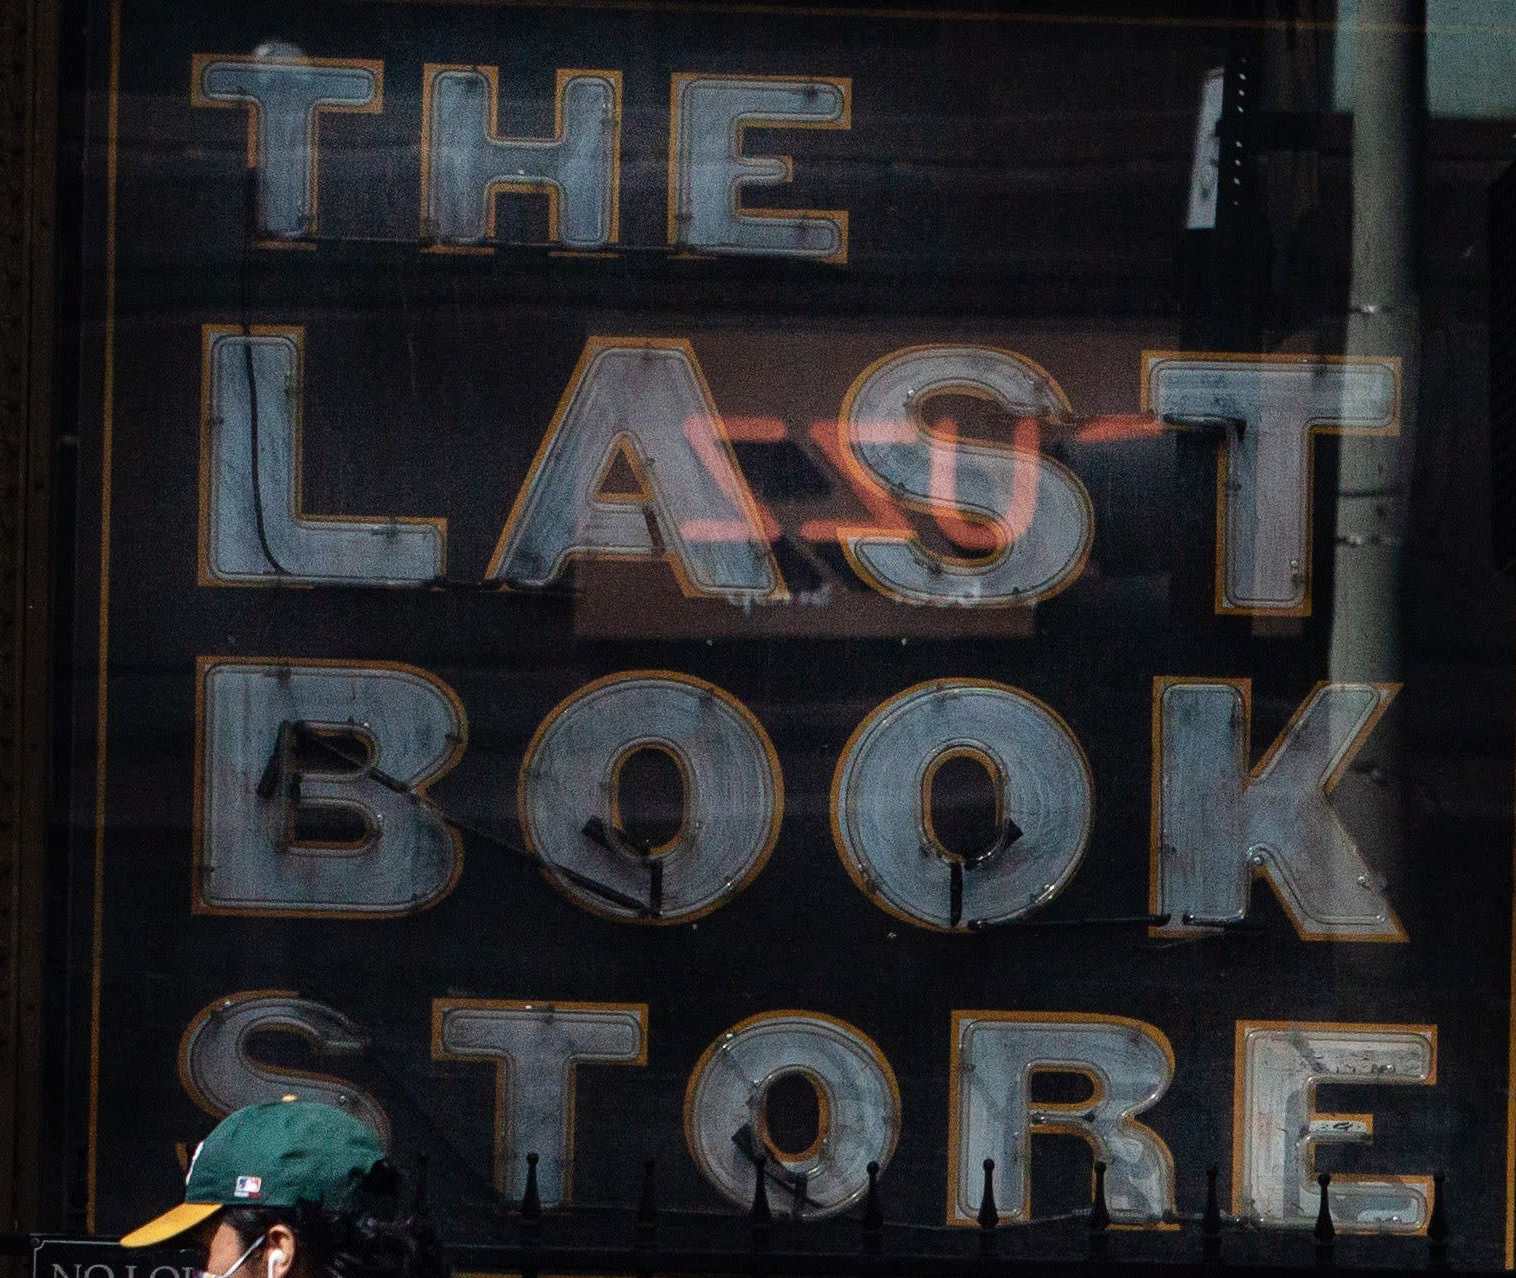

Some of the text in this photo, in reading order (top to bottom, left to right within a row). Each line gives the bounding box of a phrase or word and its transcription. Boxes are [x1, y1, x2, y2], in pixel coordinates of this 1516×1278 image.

[191, 53, 852, 265] THE
[197, 325, 1402, 616] LAST
[191, 656, 1409, 942] BOOK
[178, 989, 1438, 1236] STORE
